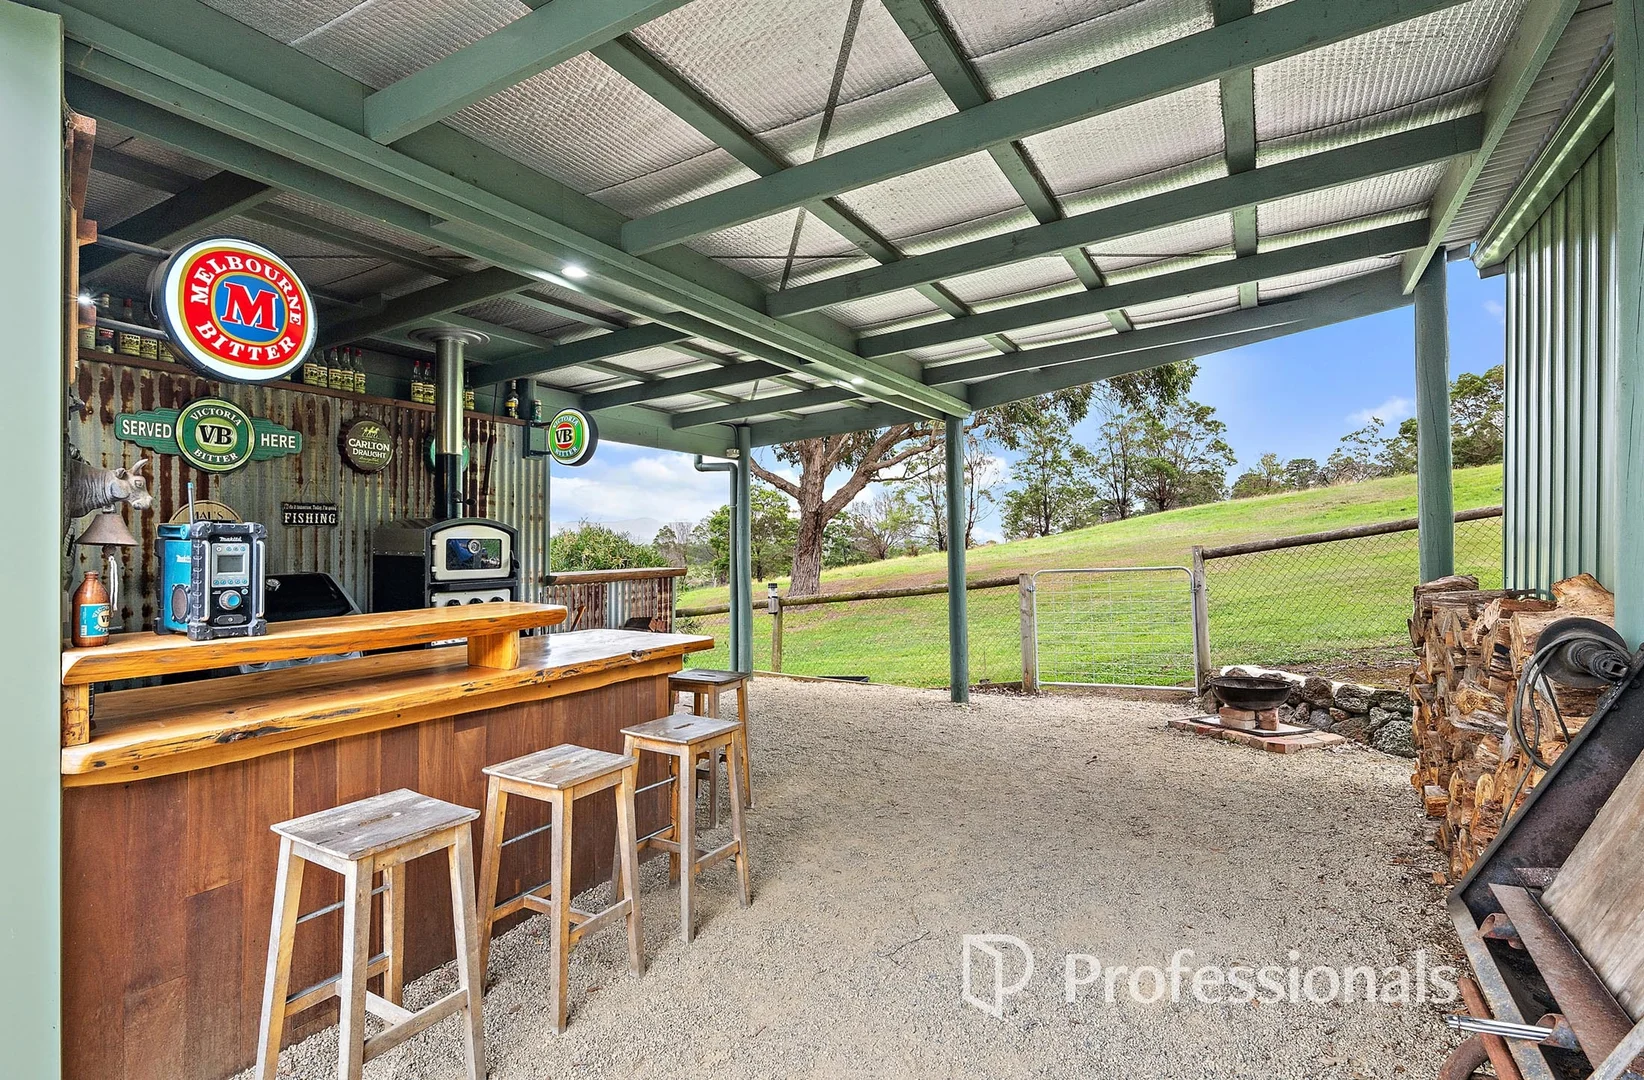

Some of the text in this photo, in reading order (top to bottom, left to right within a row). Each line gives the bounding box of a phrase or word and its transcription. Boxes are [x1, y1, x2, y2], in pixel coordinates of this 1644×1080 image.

[190, 255, 302, 327] MELBOURNE
[220, 281, 280, 333] M
[195, 320, 297, 361] BITTER
[190, 408, 242, 427] VICTORIA
[122, 419, 172, 439] SERVED
[198, 425, 233, 445] VB
[556, 429, 572, 443] VB
[260, 433, 296, 449] HERE
[348, 438, 390, 452] CARLTON
[193, 448, 238, 463] BITTER
[352, 448, 387, 459] DRAUGHT
[284, 512, 336, 524] FISHING
